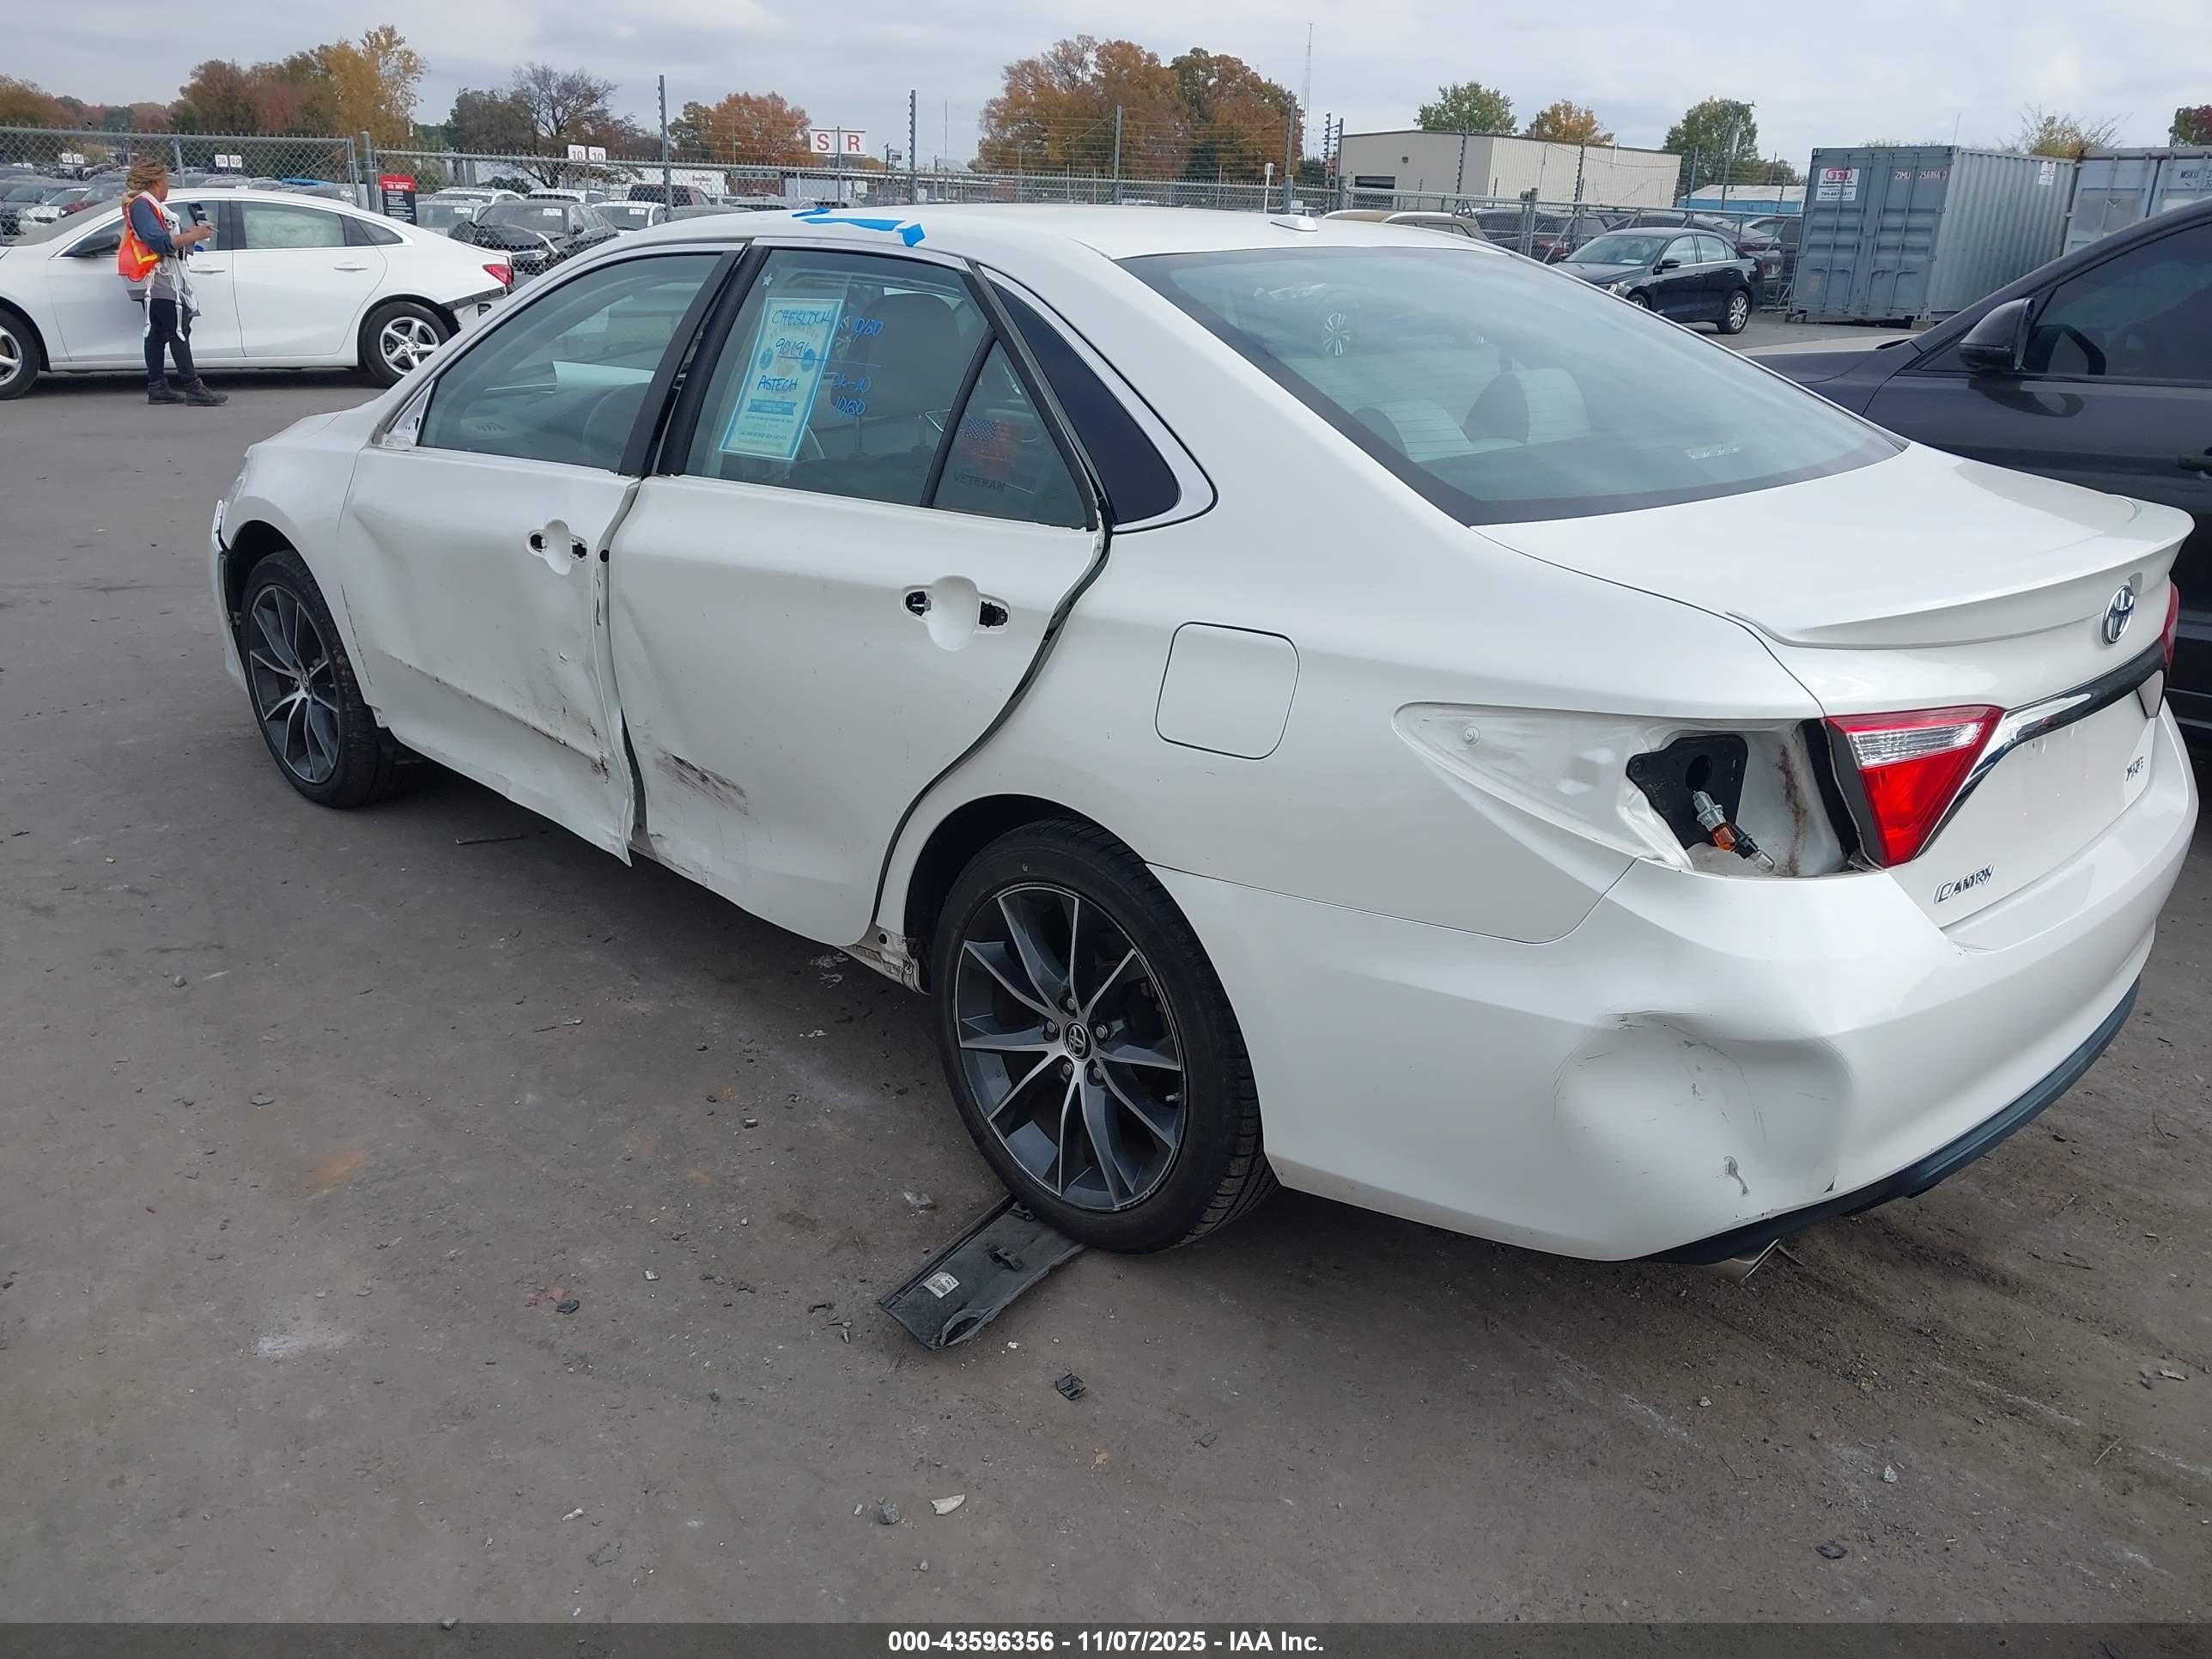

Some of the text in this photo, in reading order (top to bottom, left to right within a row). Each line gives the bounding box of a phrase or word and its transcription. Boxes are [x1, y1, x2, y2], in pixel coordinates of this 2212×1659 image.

[817, 133, 830, 151] S
[848, 134, 860, 152] R
[572, 150, 583, 161] 10
[1934, 862, 1995, 904] CAMRY
